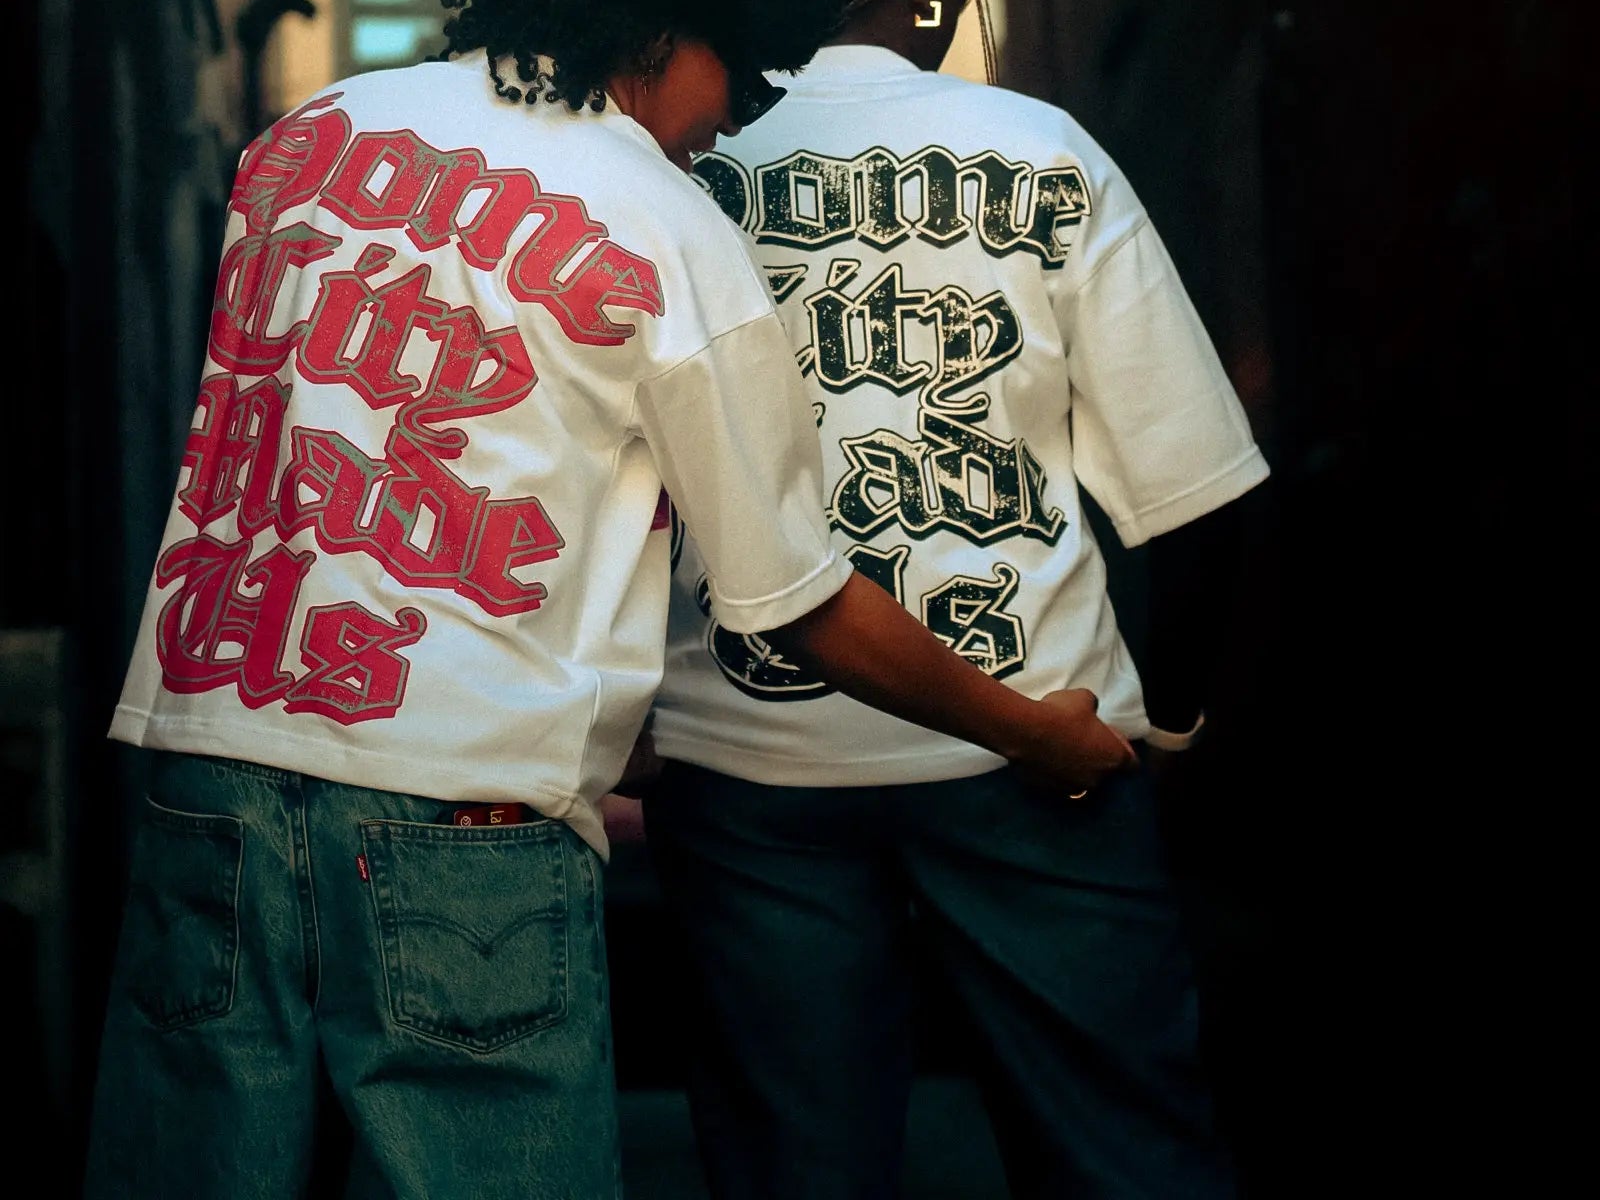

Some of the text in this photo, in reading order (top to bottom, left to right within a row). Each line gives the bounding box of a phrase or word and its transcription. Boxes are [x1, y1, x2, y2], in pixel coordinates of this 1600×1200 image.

[206, 220, 540, 461] City
[762, 259, 1025, 422] ity
[178, 373, 567, 618] Made
[808, 401, 1068, 548] ade
[155, 534, 427, 727] Us
